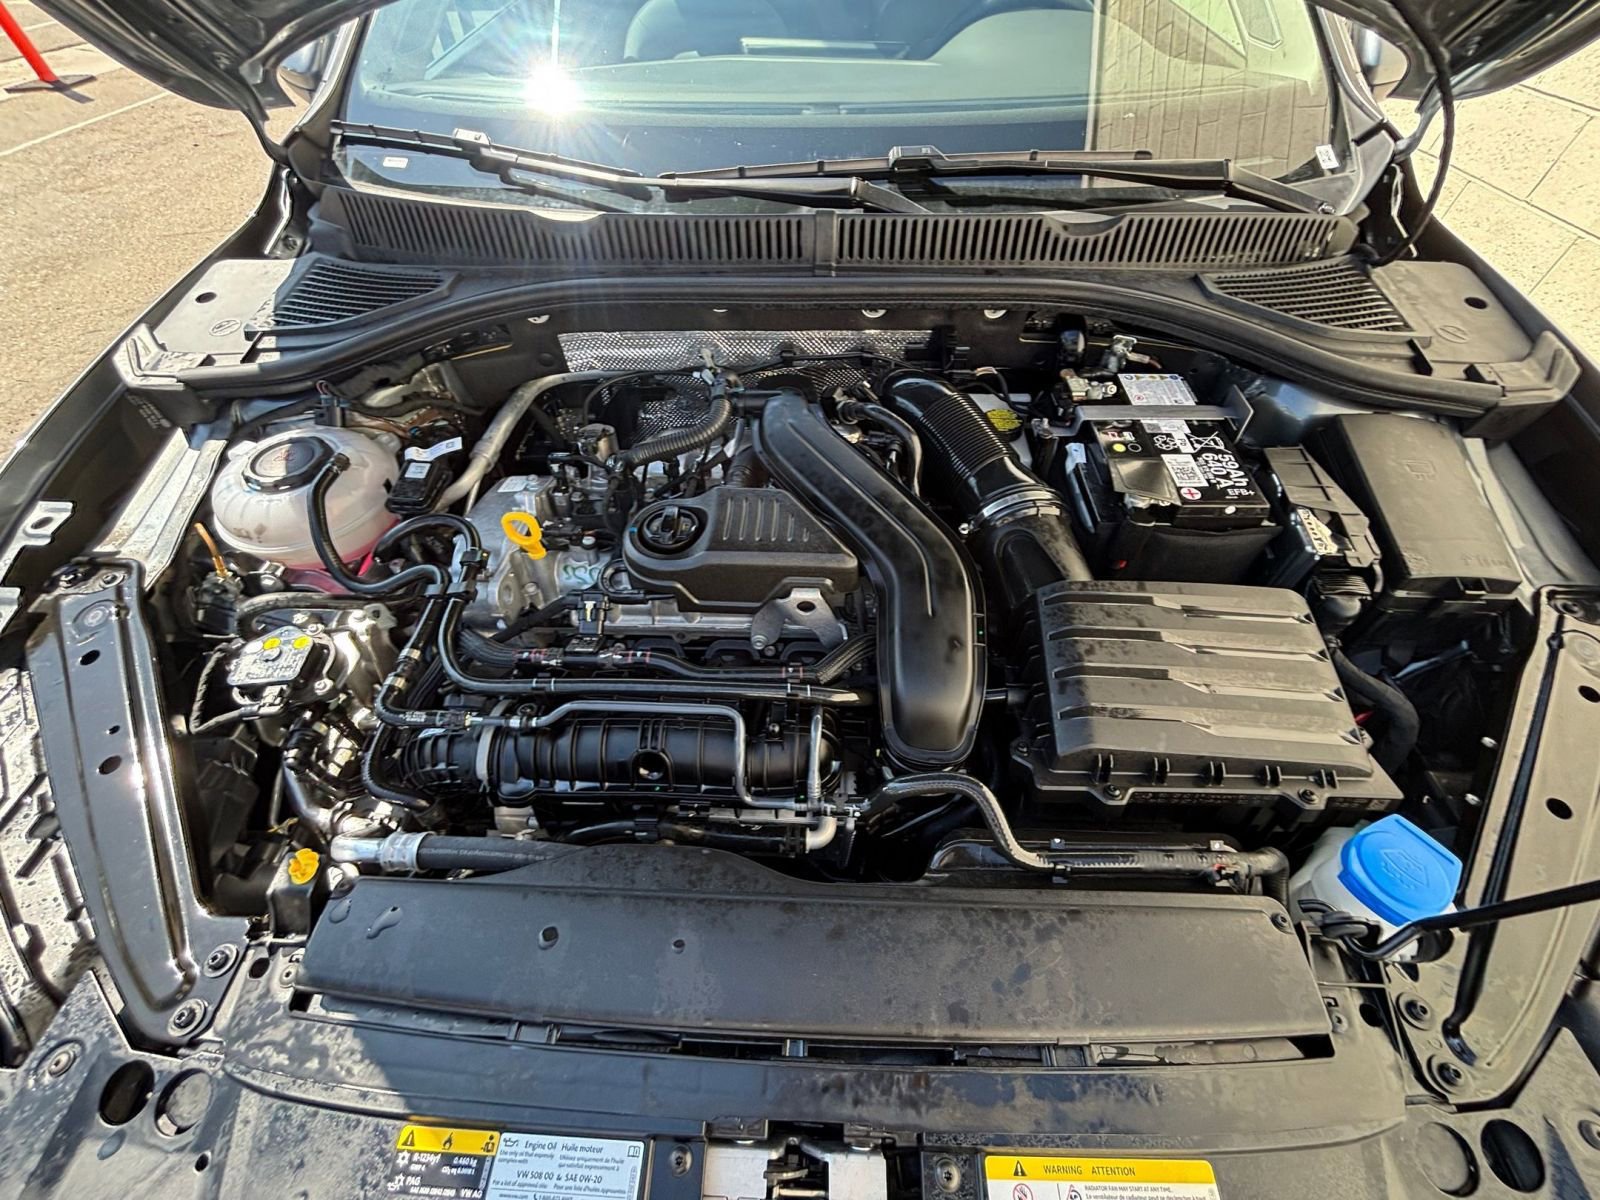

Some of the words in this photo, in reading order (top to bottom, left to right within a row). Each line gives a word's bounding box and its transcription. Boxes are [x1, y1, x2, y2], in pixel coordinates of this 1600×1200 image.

[1202, 452, 1228, 475] 640
[1216, 477, 1234, 489] A
[1218, 453, 1249, 487] 59Ah
[524, 1140, 546, 1151] Engine
[547, 1142, 557, 1150] Oil
[561, 1143, 578, 1152] Huile
[579, 1146, 603, 1154] moteur
[1043, 1164, 1083, 1176] WARNING
[1091, 1166, 1136, 1176] ATTENTION
[405, 1175, 421, 1186] PAG
[517, 1170, 529, 1179] VW
[530, 1171, 543, 1180] 508
[544, 1172, 554, 1180] 00
[564, 1173, 578, 1182] SAE
[578, 1175, 603, 1184] 0W-20
[460, 1188, 472, 1198] VW
[472, 1189, 483, 1199] AG
